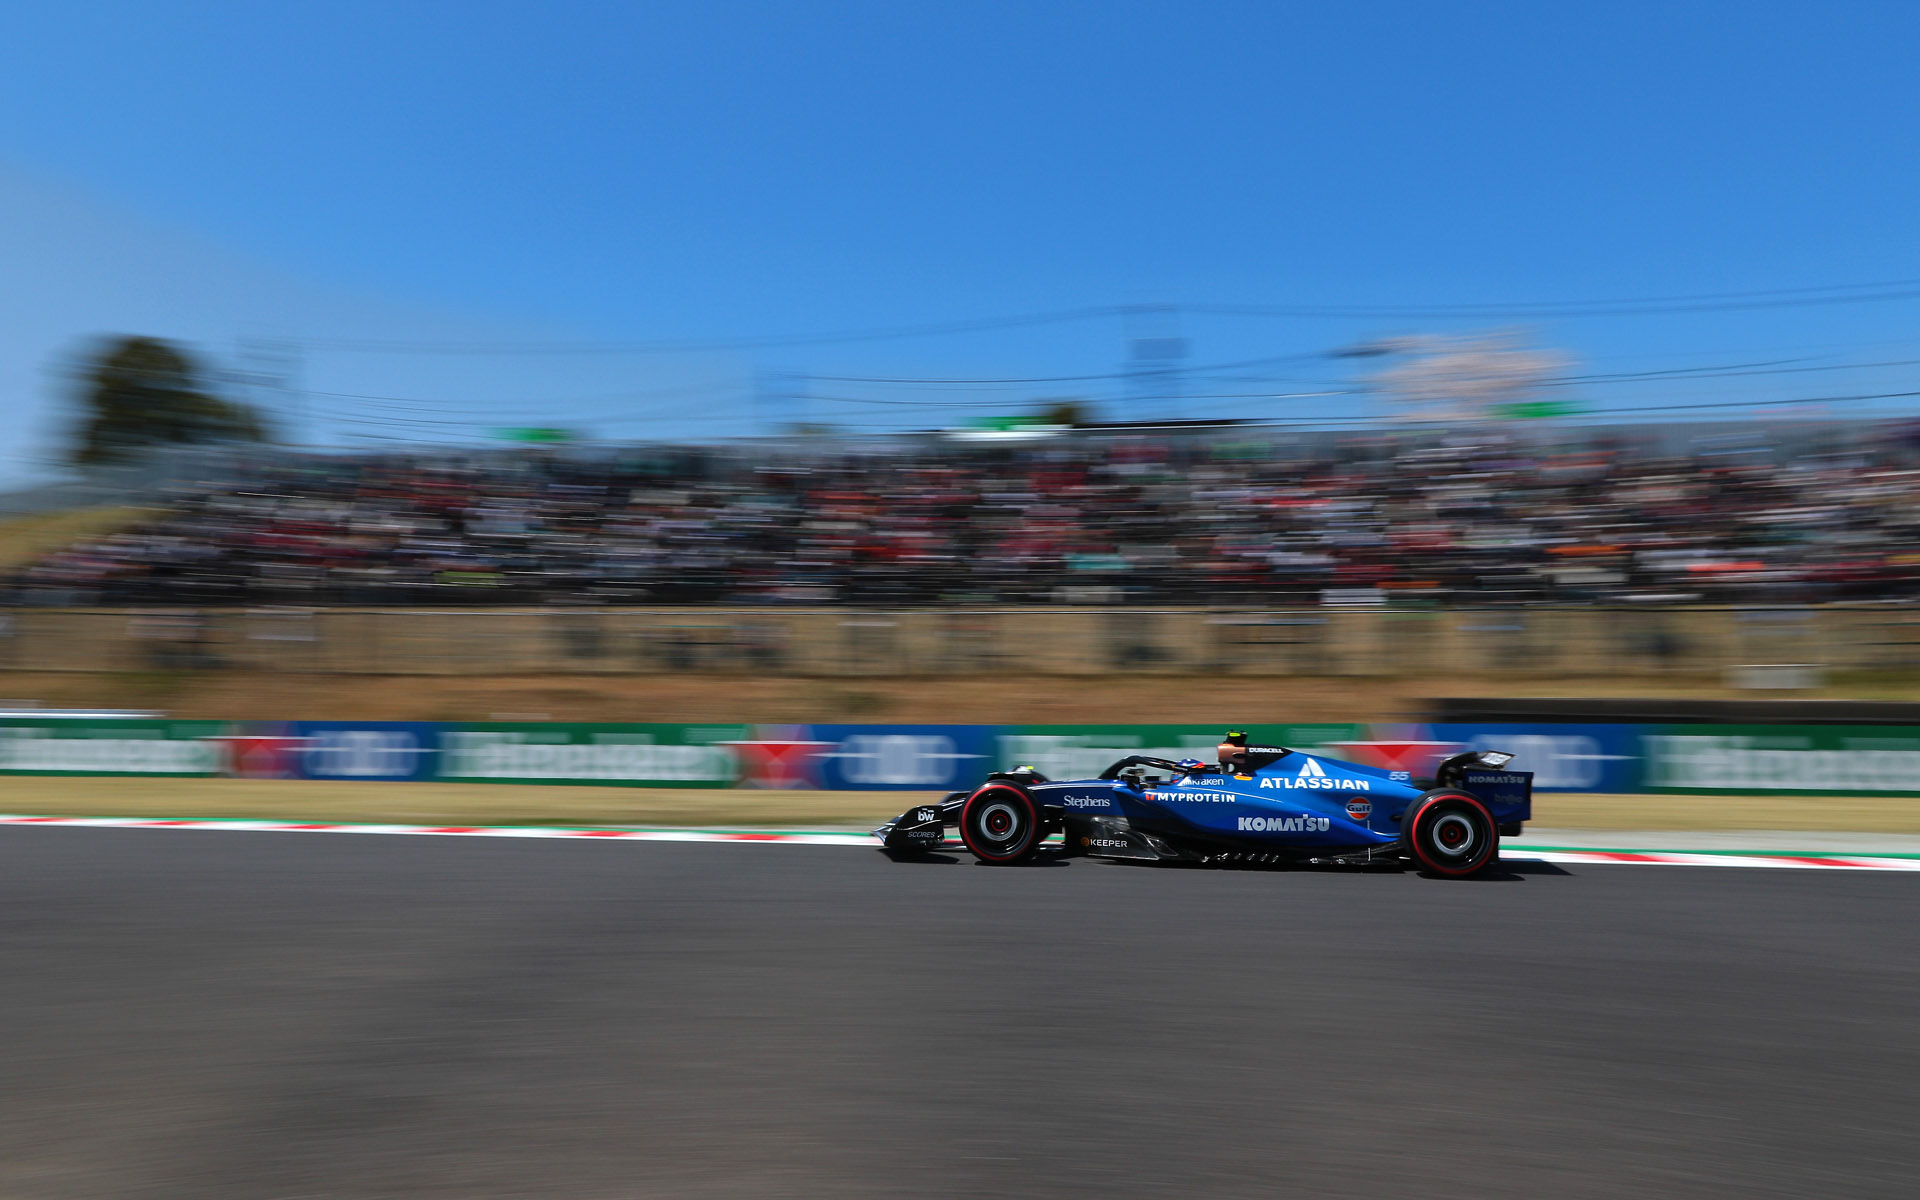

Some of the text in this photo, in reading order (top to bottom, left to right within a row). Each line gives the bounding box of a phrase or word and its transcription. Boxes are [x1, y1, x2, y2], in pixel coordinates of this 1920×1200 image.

[1389, 771, 1410, 780] 55
[1469, 775, 1525, 783] KOMATSU
[1260, 777, 1370, 791] ATLASSIAN
[1063, 795, 1111, 808] Stephens
[1157, 793, 1235, 802] MYPROTEIN
[1347, 804, 1371, 812] Gulf
[1238, 814, 1330, 831] KOMATSU
[1090, 838, 1128, 848] KEEPER
